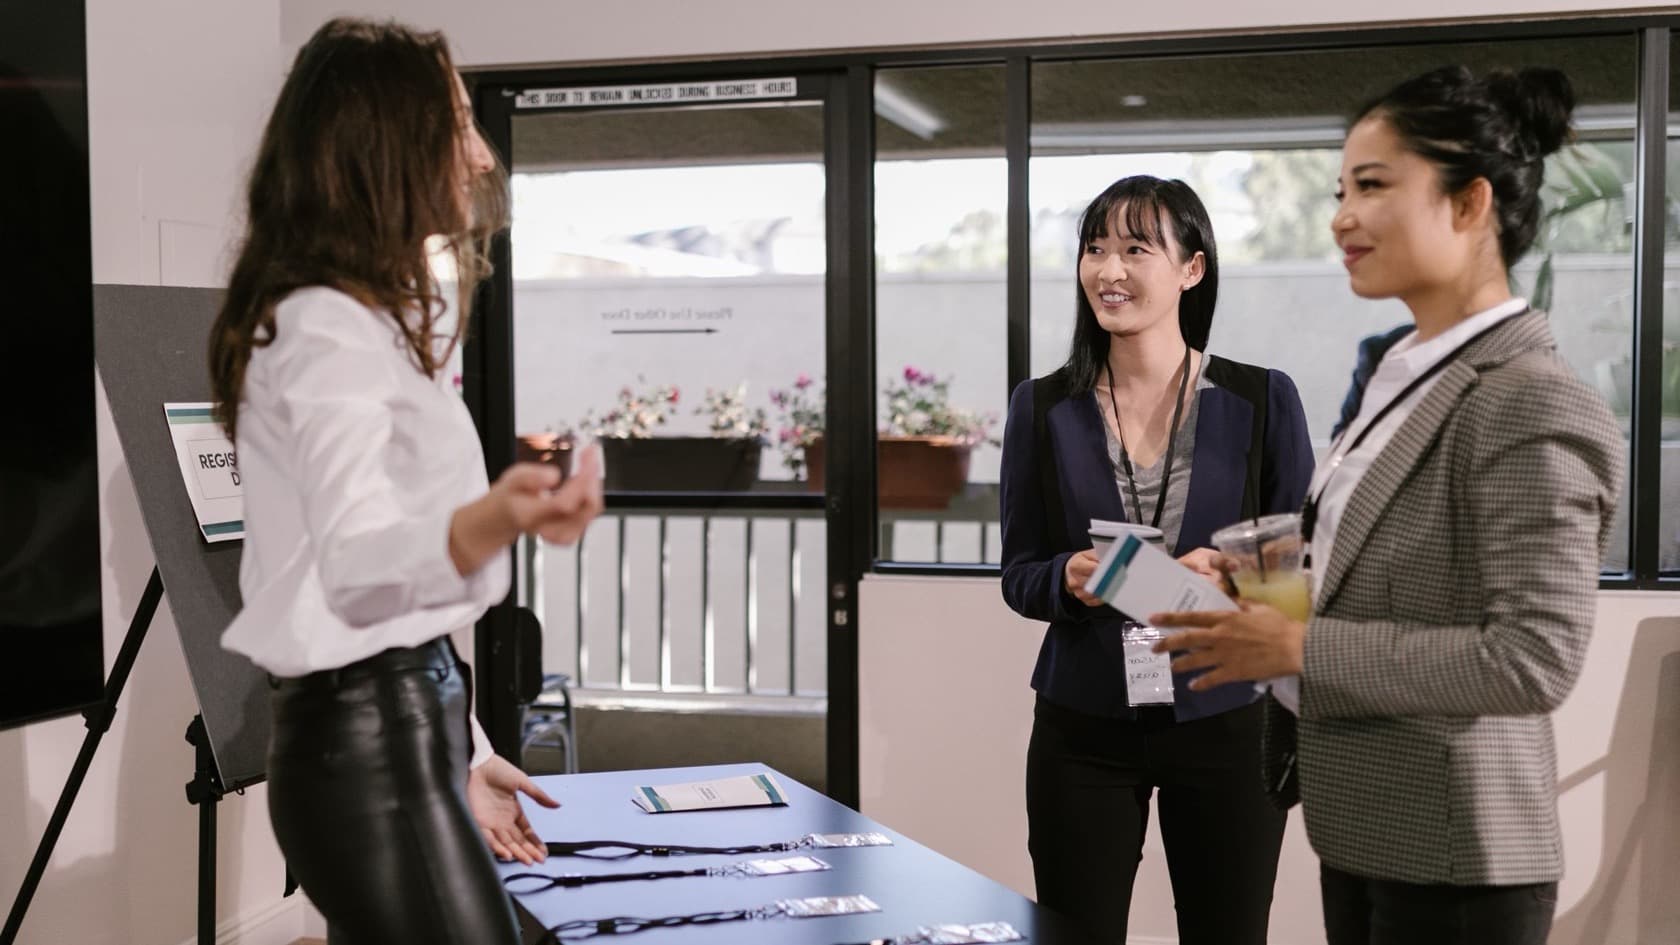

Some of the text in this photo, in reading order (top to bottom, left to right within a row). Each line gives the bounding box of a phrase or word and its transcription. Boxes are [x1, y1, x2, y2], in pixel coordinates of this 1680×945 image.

[679, 86, 709, 98] DURING
[716, 84, 757, 97] BUSINESS
[763, 82, 792, 95] HOURS
